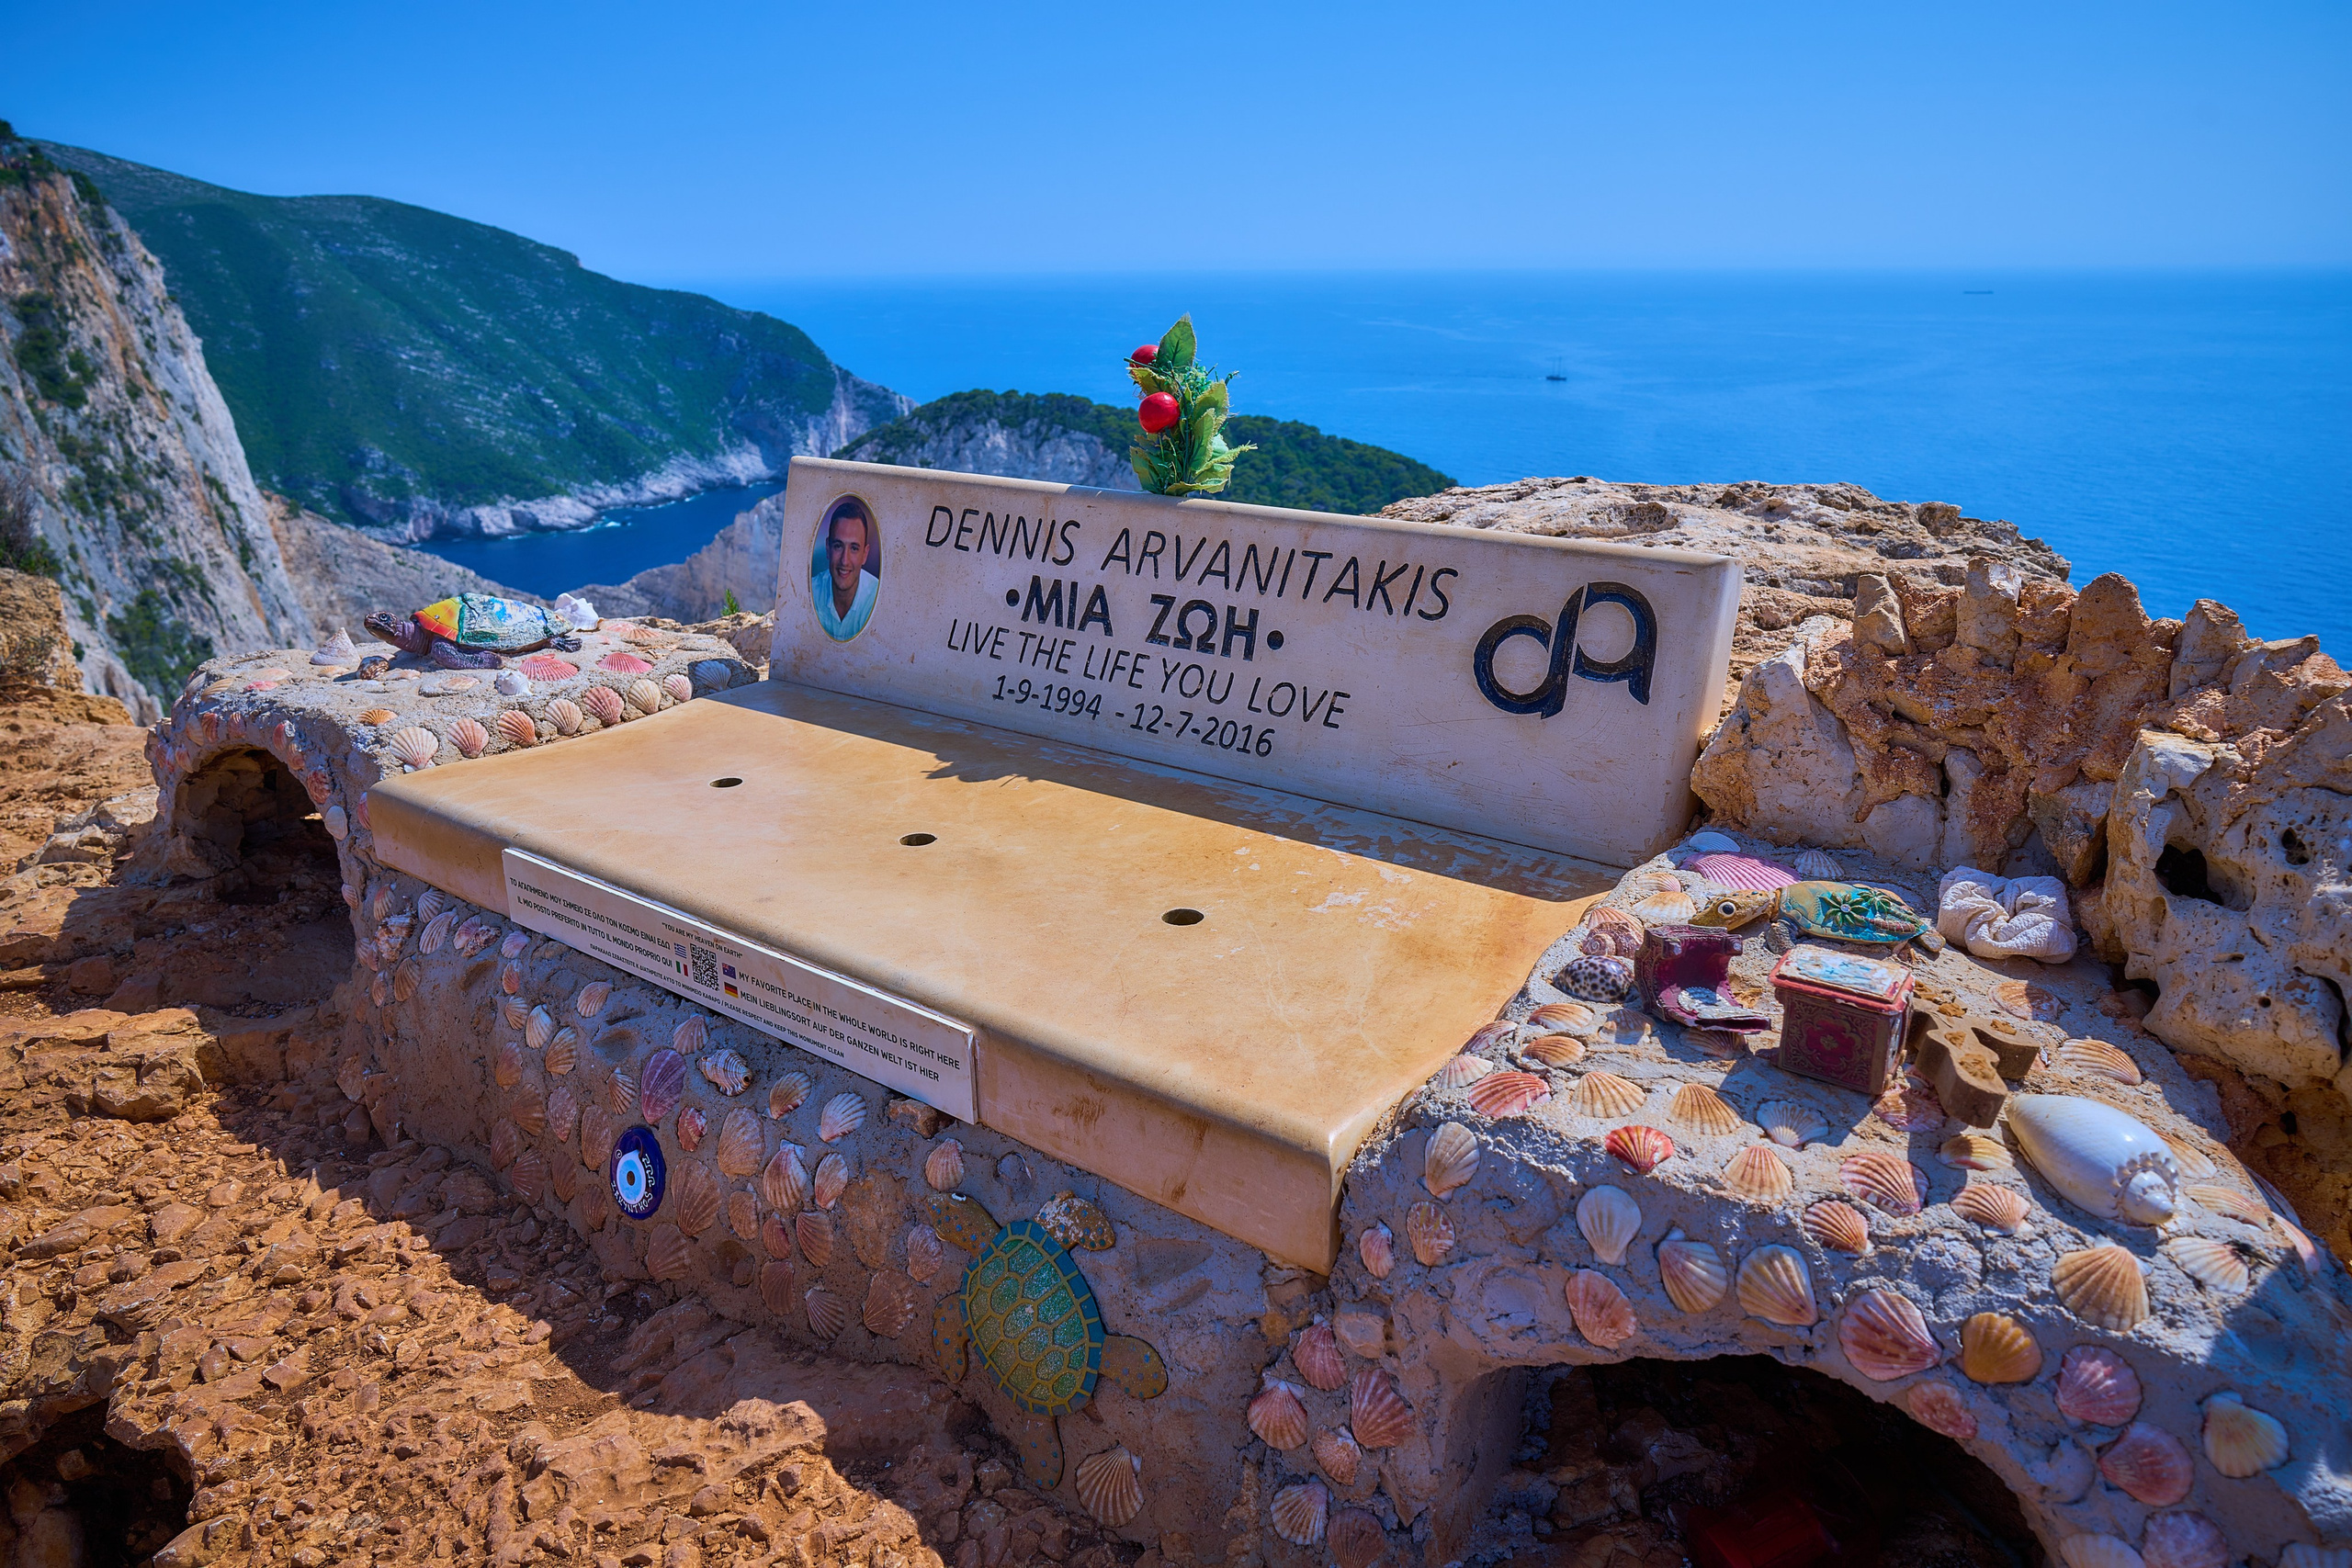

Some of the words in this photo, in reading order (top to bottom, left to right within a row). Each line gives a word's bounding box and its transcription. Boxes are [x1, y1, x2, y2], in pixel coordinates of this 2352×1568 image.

[925, 505, 1080, 566] DENNIS
[1101, 528, 1458, 620] ARVANITAKIS
[947, 618, 1010, 660] LIVE
[1019, 631, 1077, 673] THE
[1083, 645, 1150, 689] LIFE
[1160, 658, 1234, 705] YOU
[1247, 677, 1351, 729] LOVE
[992, 674, 1102, 720] 1-9-1994
[516, 895, 523, 905] IL
[522, 897, 533, 908] MIO
[533, 902, 551, 917] POSTO
[550, 909, 580, 929] PREFERITO
[580, 921, 587, 931] IN
[587, 924, 605, 939] TUTTO
[605, 932, 612, 942] IL
[611, 934, 634, 951] MONDO
[634, 943, 661, 962] PROPRIO
[661, 954, 673, 967] QUI
[674, 927, 685, 937] ARE
[685, 931, 694, 940] MY
[694, 934, 714, 948] HEAVEN
[715, 942, 723, 952] ON
[723, 1000, 741, 1014] PLEASE
[741, 1008, 763, 1023] RESPECT
[763, 1017, 773, 1028] AND
[774, 1021, 786, 1033] KEEP
[786, 1028, 797, 1038] THIS
[798, 1032, 827, 1051] MONUMENT
[827, 1044, 844, 1058] CLEAN
[738, 971, 750, 984] MY
[751, 976, 786, 998] FAVORITE
[787, 990, 811, 1009] PLACE
[812, 1000, 820, 1012] IN
[822, 1005, 837, 1020] THE
[838, 1011, 866, 1032] WHOLE
[867, 1023, 897, 1043] WORLD
[899, 1036, 908, 1048] IS
[909, 1040, 934, 1059] RIGHT
[936, 1051, 960, 1069] HERE
[740, 990, 758, 1006] MEIN
[759, 998, 810, 1028] LIEBLINGSORT
[811, 1020, 828, 1034] AUF
[829, 1027, 845, 1042] DER
[846, 1034, 879, 1056] GANZEN
[880, 1048, 902, 1066] WELT
[904, 1058, 918, 1073] IST
[919, 1065, 939, 1081] HIER
